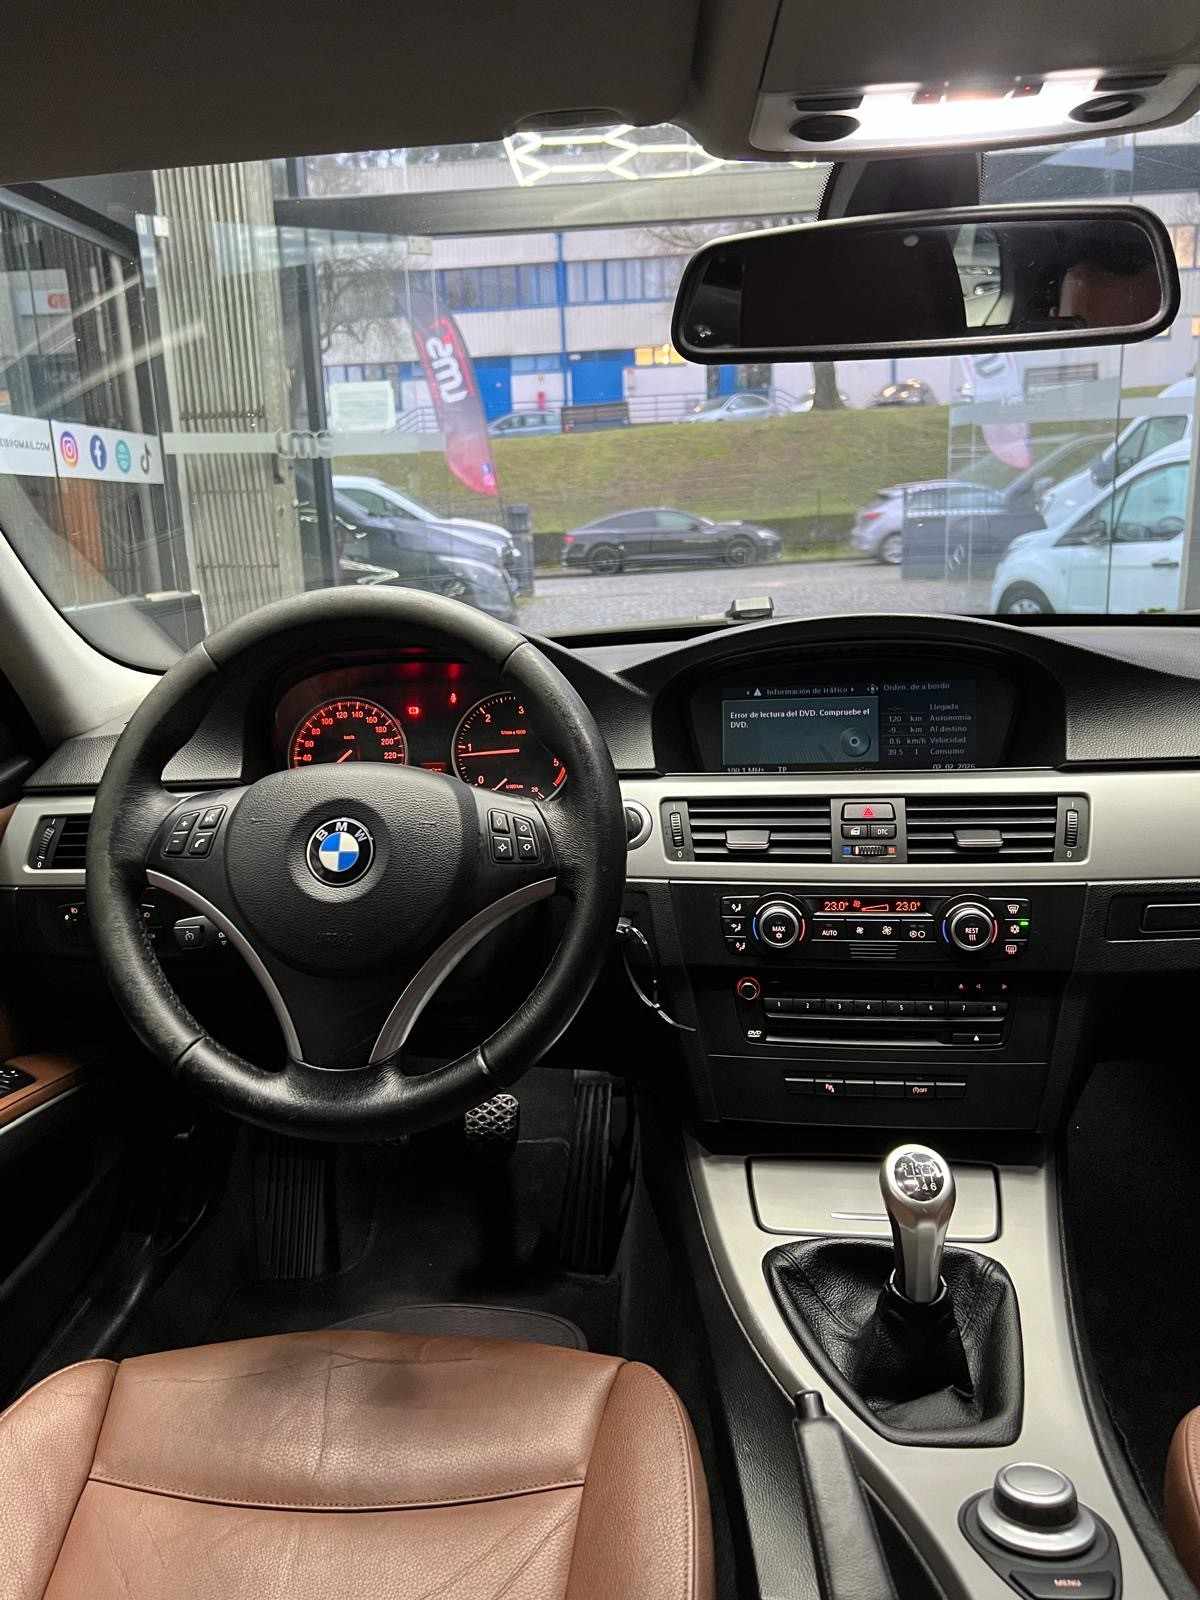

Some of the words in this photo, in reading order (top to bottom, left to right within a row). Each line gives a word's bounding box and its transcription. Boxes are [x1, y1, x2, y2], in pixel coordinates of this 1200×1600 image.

[812, 687, 821, 695] de
[518, 705, 525, 715] 3
[730, 711, 748, 719] Error
[749, 711, 758, 719] de
[760, 710, 784, 719] lectura
[786, 710, 798, 718] del
[799, 709, 818, 718] DVD.
[819, 708, 862, 719] Compruebe
[863, 708, 870, 716] el
[336, 711, 348, 719] 120
[352, 711, 364, 719] 140
[485, 713, 492, 723] 2
[321, 717, 334, 725] 100
[366, 716, 378, 724] 160
[730, 720, 749, 729] DVD.
[311, 727, 321, 735] 80
[375, 725, 388, 733] 180
[381, 737, 395, 746] 200
[930, 736, 967, 744] Velocidad
[304, 740, 315, 749] 60
[467, 743, 474, 752] 1
[302, 753, 313, 762] 40
[384, 751, 398, 760] 220
[553, 758, 560, 767] 5
[478, 775, 485, 785] 0
[315, 821, 368, 843] BMW
[877, 828, 889, 836] DTC
[771, 925, 786, 933] MAX
[821, 929, 838, 937] AUTO
[964, 927, 979, 935] REST
[747, 1030, 762, 1038] DVD
[930, 1182, 937, 1191] 6
